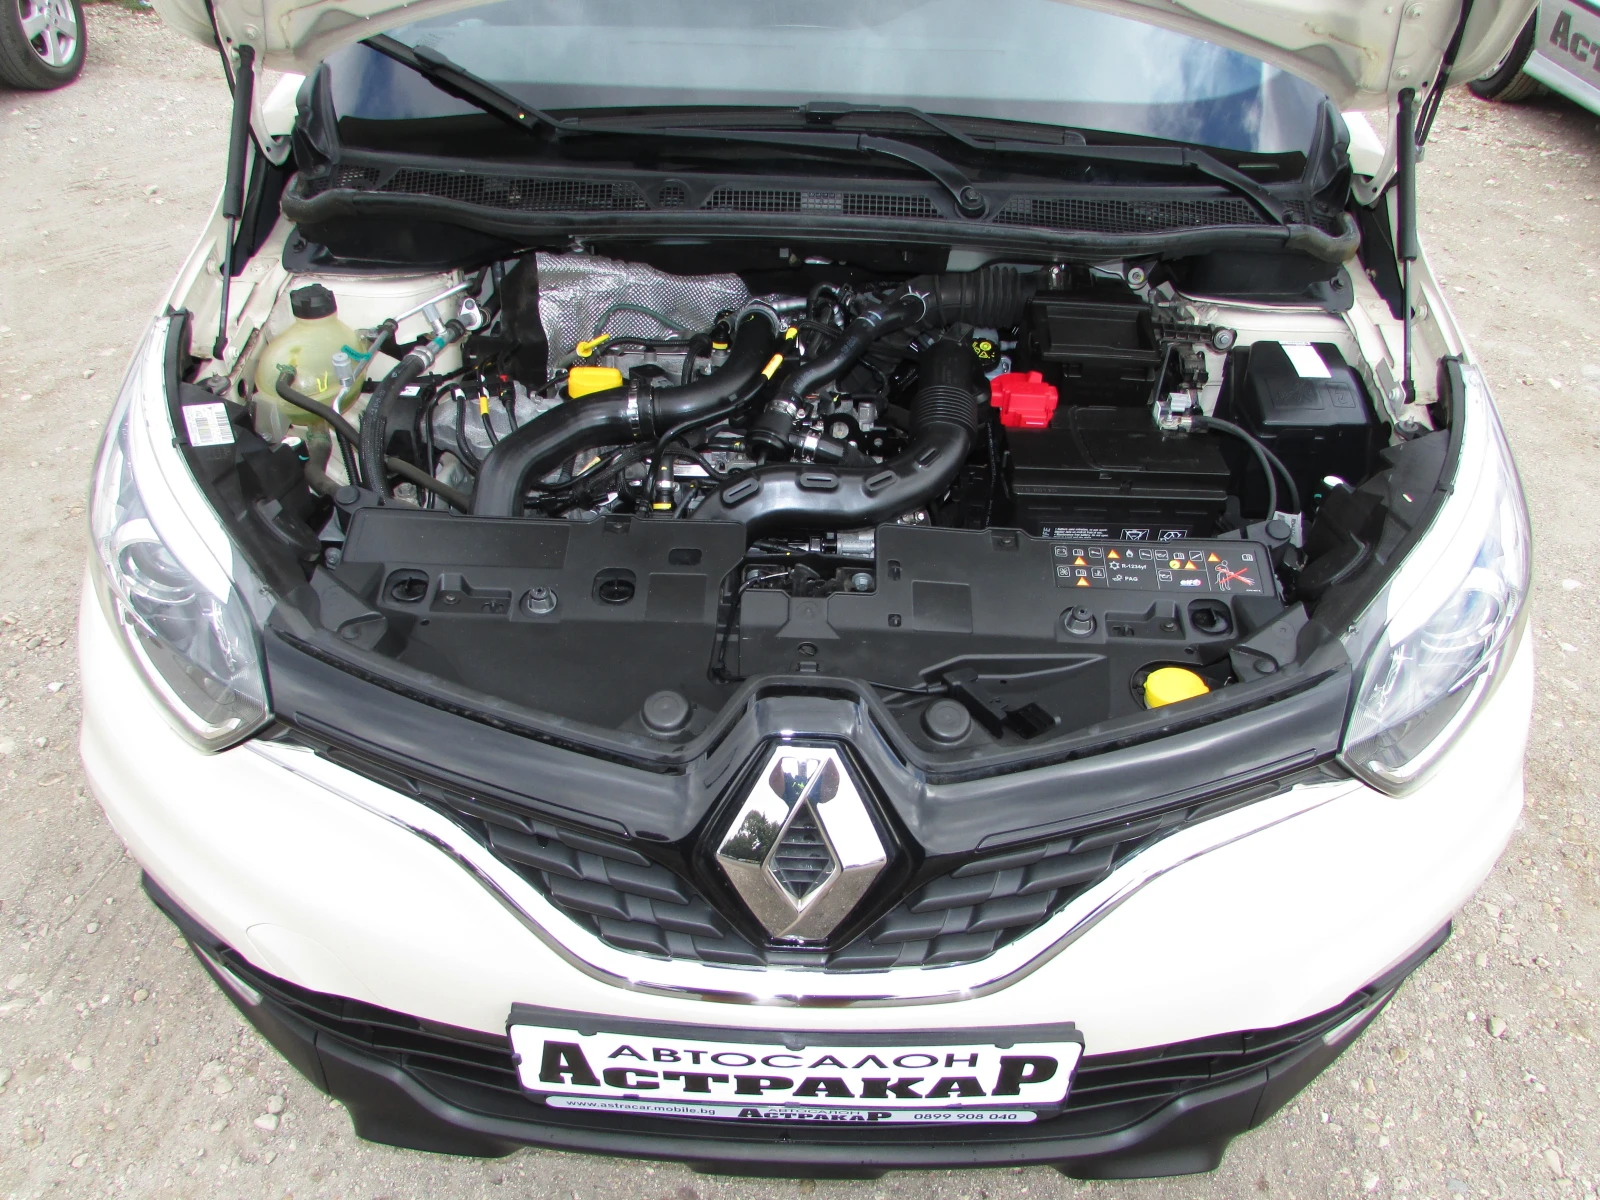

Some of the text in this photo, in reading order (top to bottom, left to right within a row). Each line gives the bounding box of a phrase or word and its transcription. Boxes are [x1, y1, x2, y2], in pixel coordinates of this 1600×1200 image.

[606, 1044, 980, 1069] АВТОСАЛОН
[566, 1099, 716, 1115] www.astracar.mobile.bg
[913, 1112, 1018, 1121] 0899 908 040
